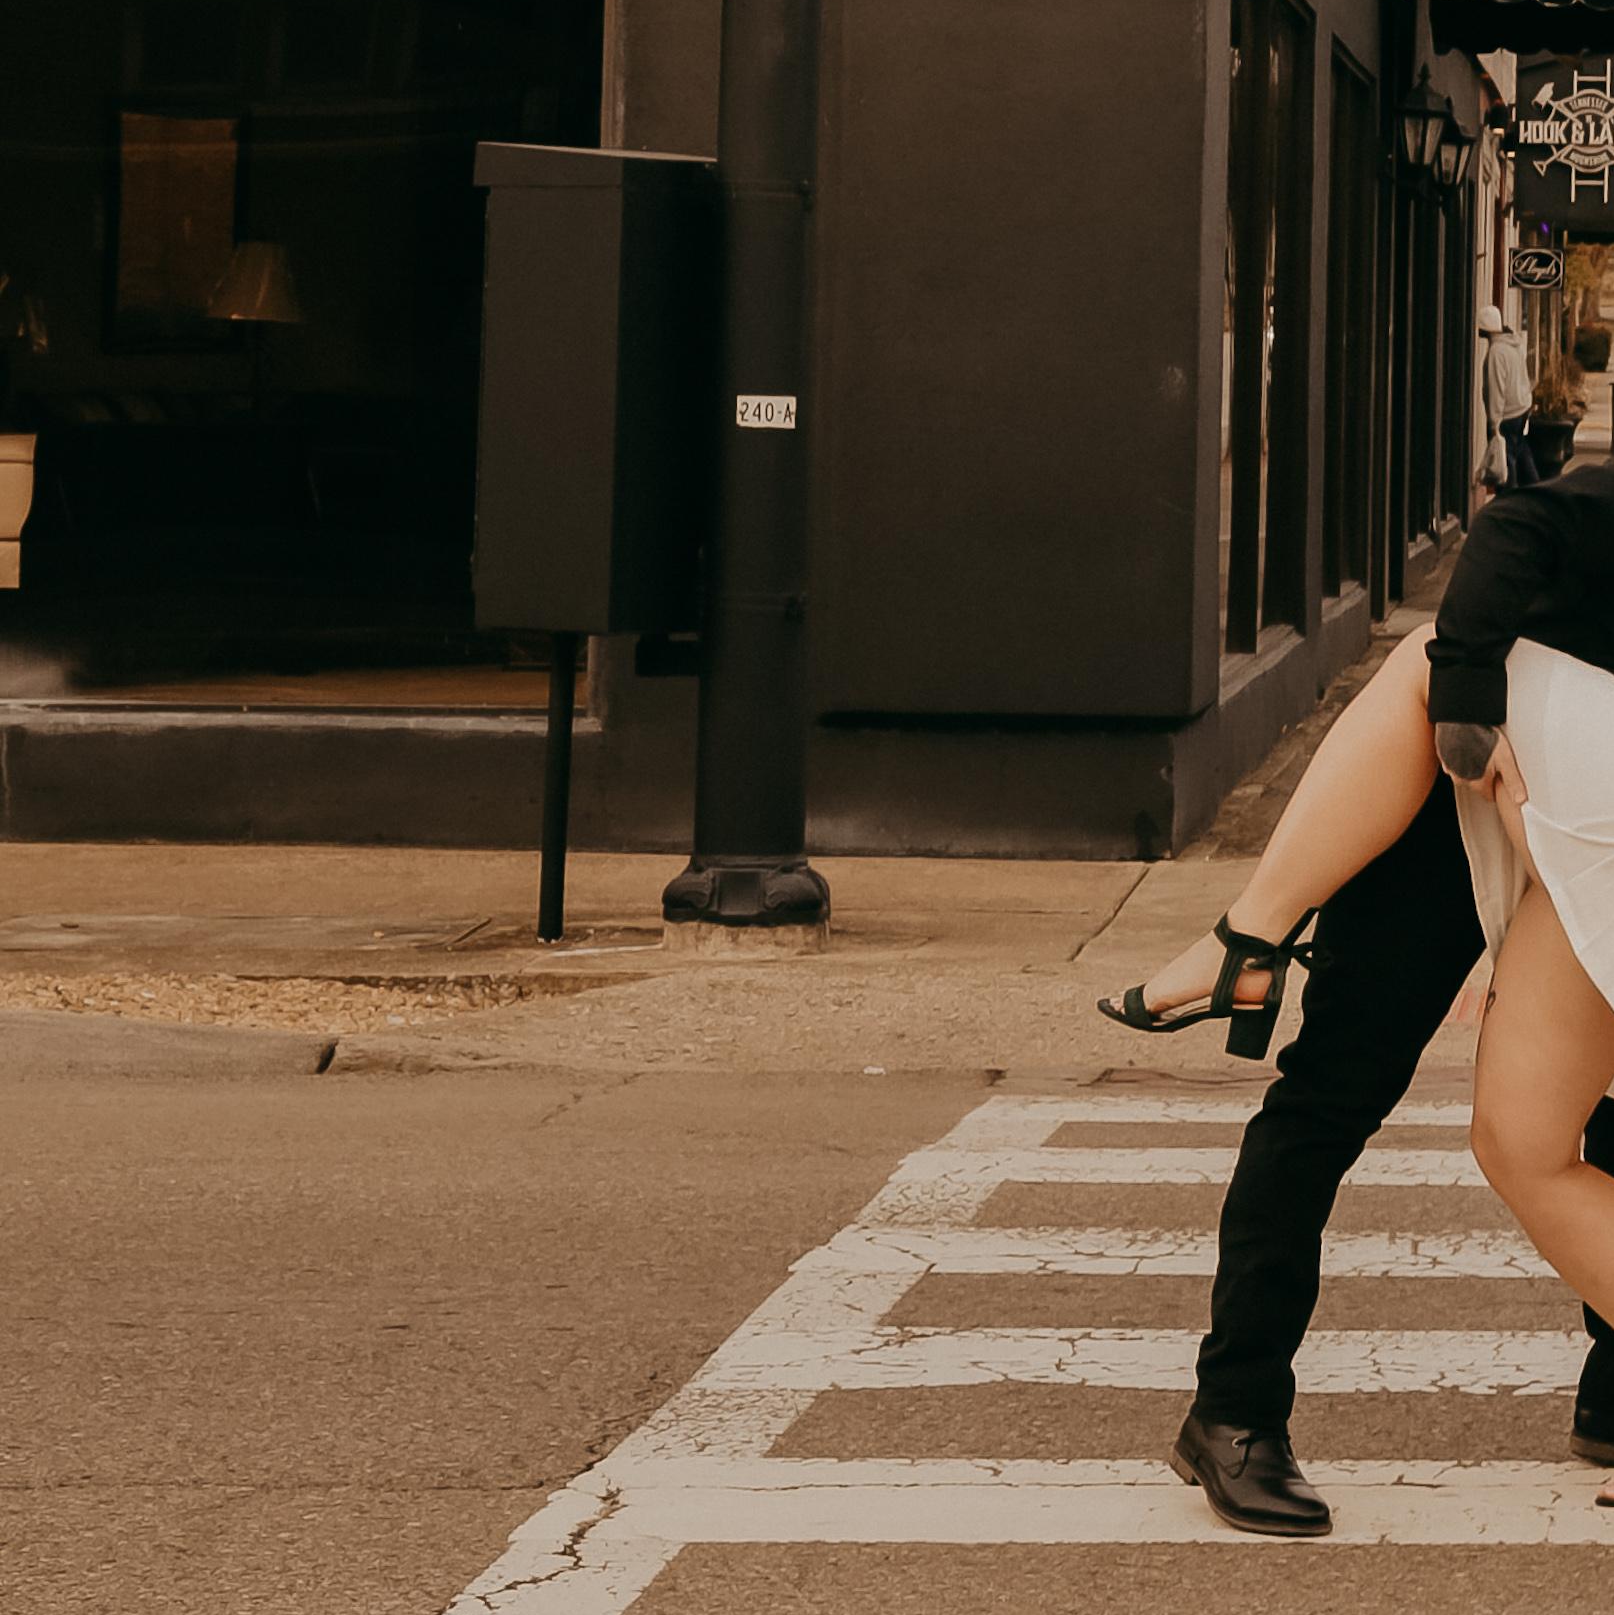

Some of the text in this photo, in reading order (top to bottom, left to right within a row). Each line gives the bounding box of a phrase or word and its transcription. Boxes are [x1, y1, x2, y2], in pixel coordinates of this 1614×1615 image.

[1519, 120, 1567, 144] HOOK
[1572, 122, 1585, 144] &
[739, 401, 793, 423] 240-A
